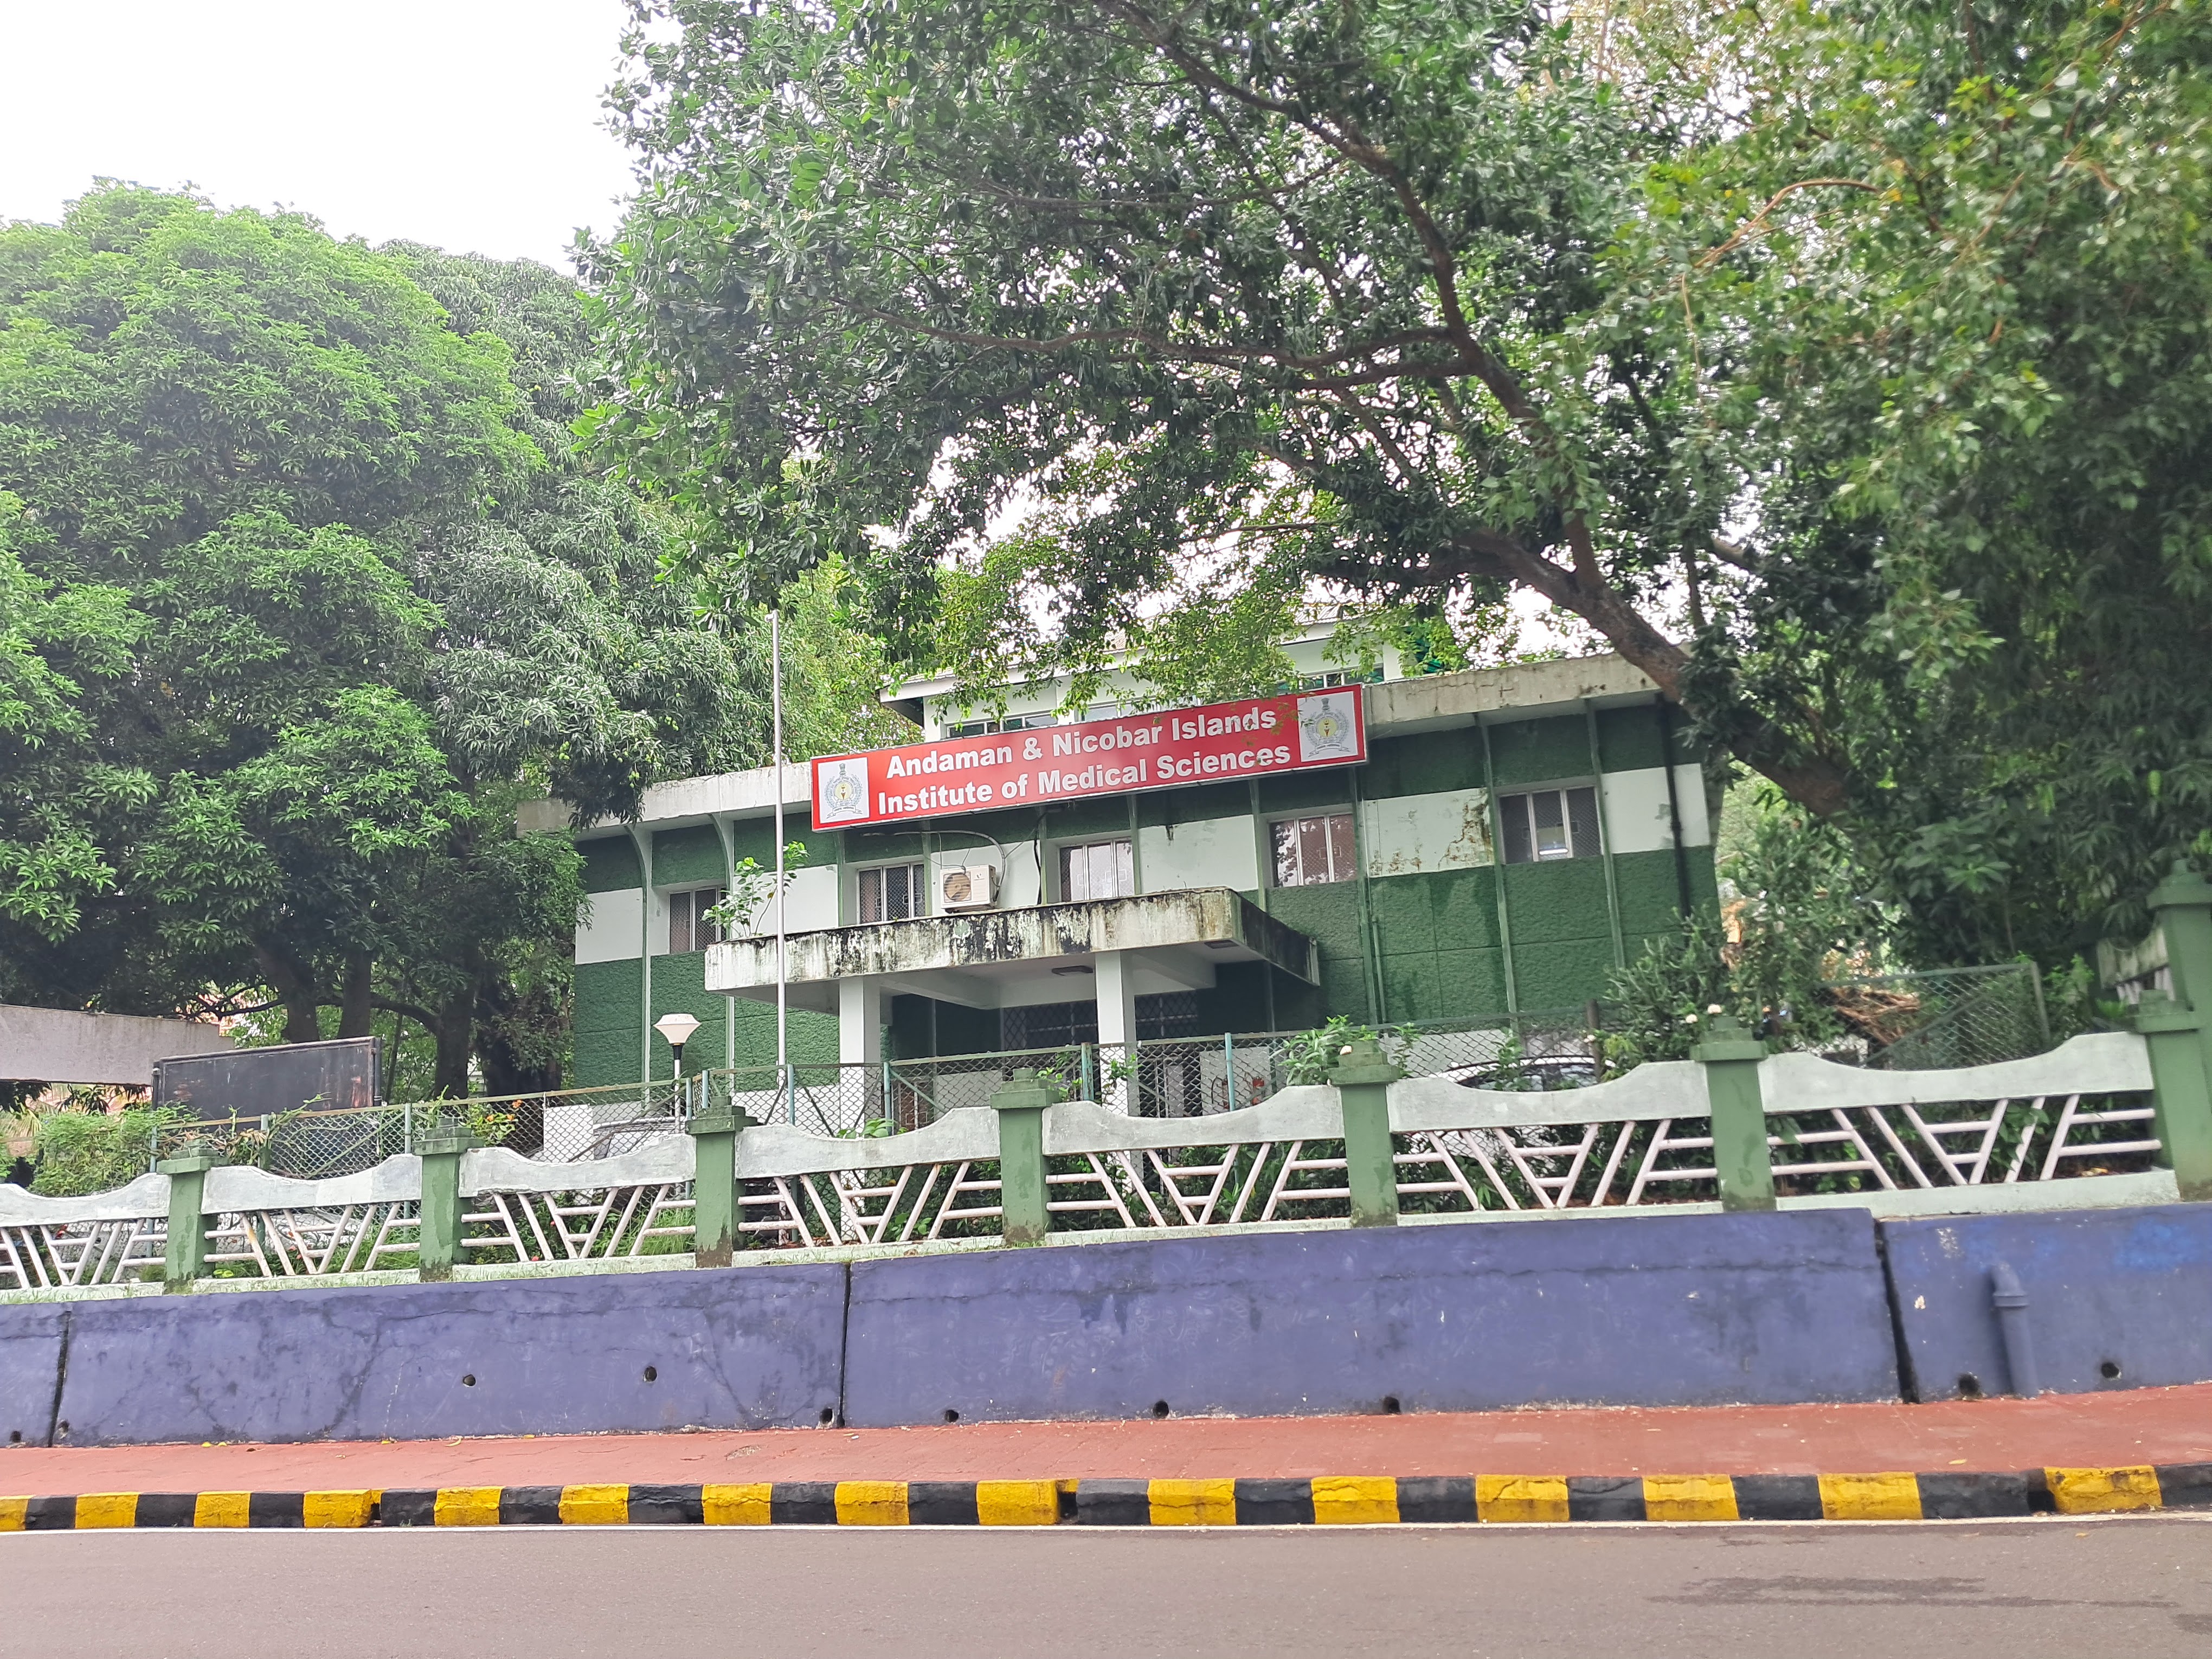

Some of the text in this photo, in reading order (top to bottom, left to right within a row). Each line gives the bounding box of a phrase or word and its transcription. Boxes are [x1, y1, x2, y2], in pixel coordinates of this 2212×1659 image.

[886, 707, 1277, 779] Andaman & Nicobar Islands
[879, 745, 1291, 814] Institute of Medical Sciences
